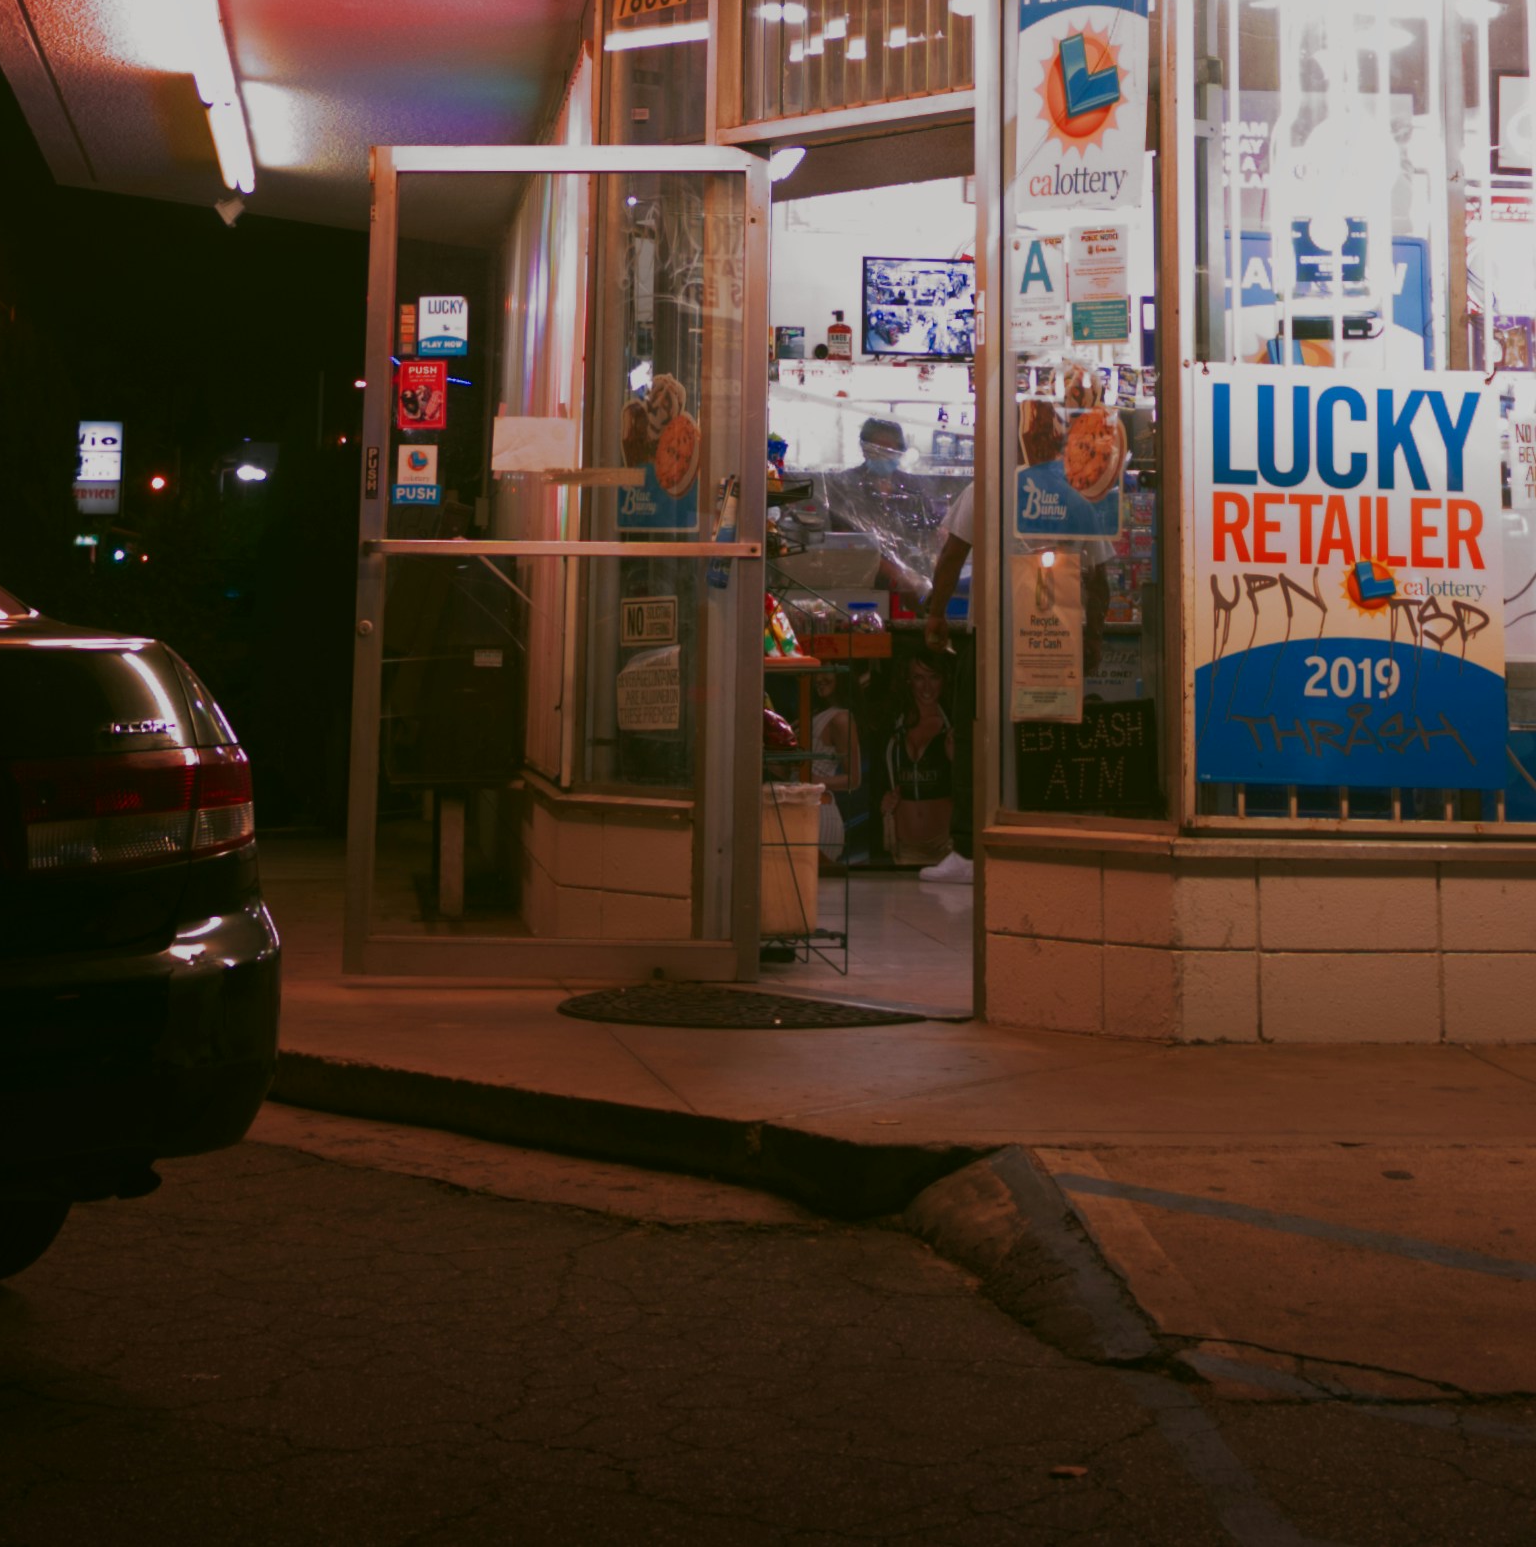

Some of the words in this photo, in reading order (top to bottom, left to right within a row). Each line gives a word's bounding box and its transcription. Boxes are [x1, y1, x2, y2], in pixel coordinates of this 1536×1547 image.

[1029, 164, 1128, 200] calottery
[1020, 240, 1054, 294] A
[428, 300, 464, 314] LUCKY
[421, 341, 443, 349] PLAY
[409, 366, 438, 375] PUSH
[1211, 382, 1482, 492] LUCKY
[1515, 424, 1531, 444] NO
[368, 449, 377, 491] PUSH
[396, 487, 437, 501] PUSH
[1211, 491, 1486, 571] RETAILER
[1403, 577, 1488, 600] calottery
[627, 605, 644, 637] NO
[1028, 637, 1041, 650] For
[1043, 637, 1062, 650] Cash
[1303, 656, 1401, 700] 2019
[1076, 710, 1144, 750] CASH
[1043, 755, 1125, 801] ATM
